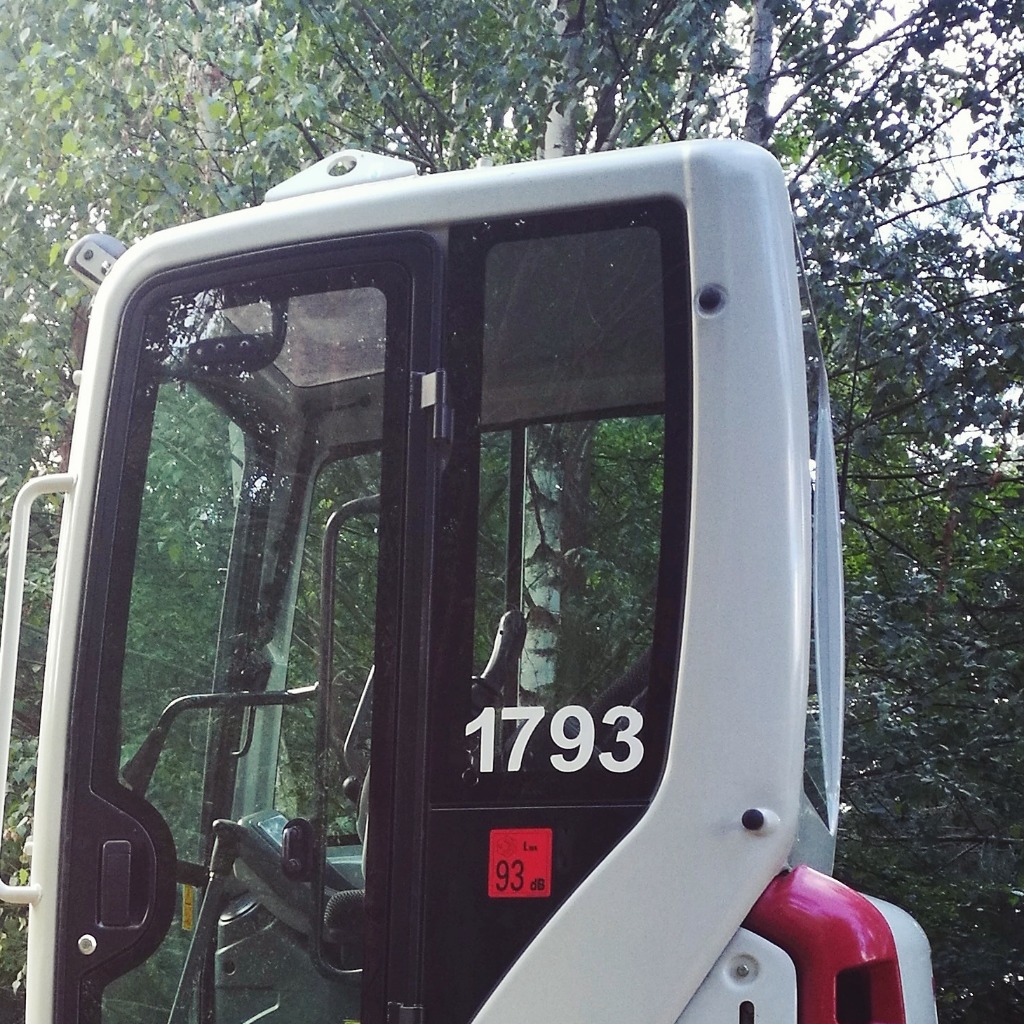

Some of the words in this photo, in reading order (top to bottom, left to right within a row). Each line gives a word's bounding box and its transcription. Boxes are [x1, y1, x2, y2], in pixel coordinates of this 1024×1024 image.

[465, 704, 645, 773] 1793
[496, 860, 524, 892] 93
[530, 878, 545, 891] dB
